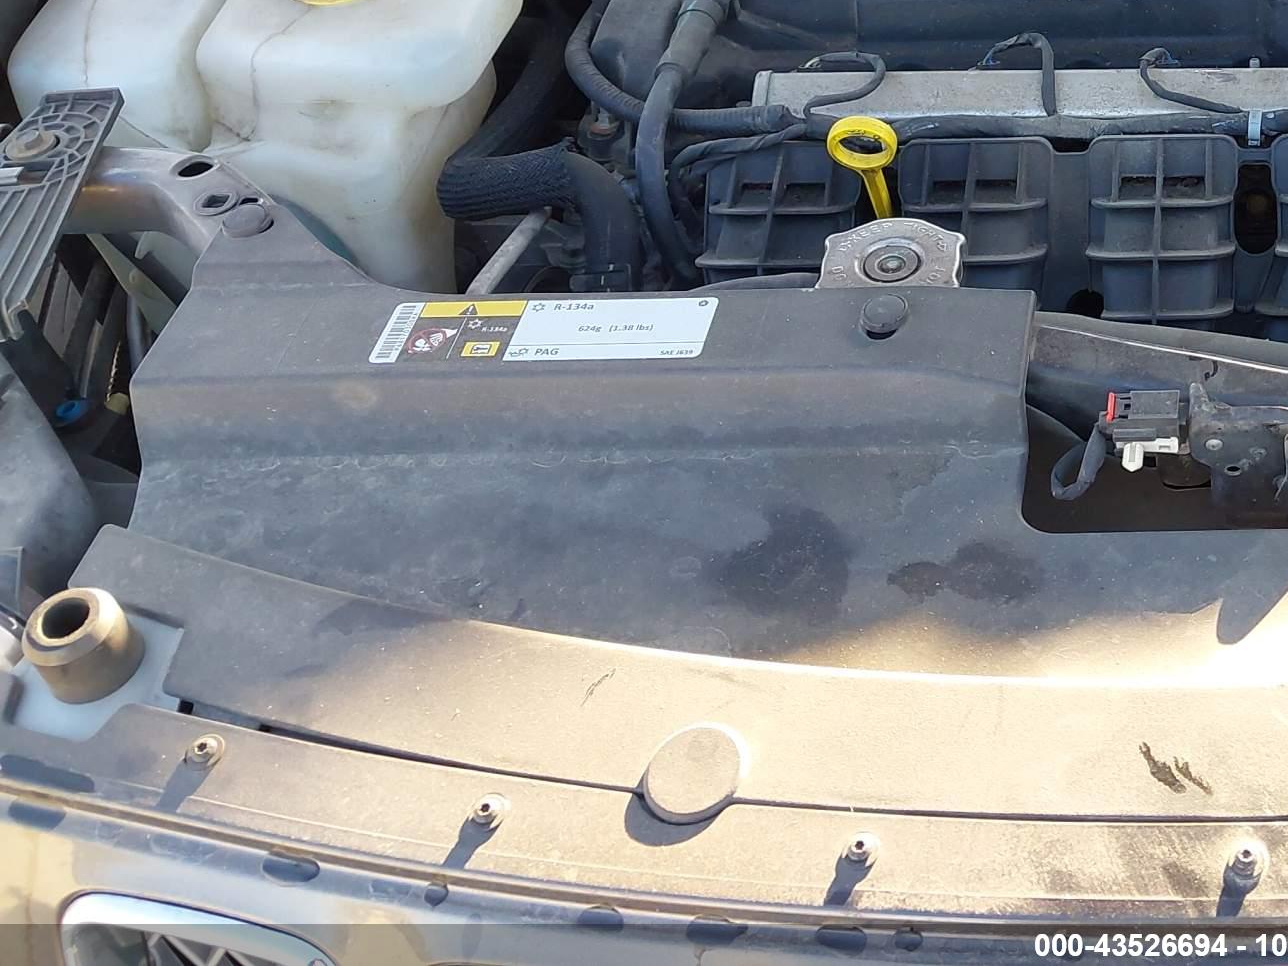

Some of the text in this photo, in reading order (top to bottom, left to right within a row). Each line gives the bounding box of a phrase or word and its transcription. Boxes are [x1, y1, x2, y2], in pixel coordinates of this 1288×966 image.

[553, 302, 595, 311] R-134a
[577, 323, 654, 333] 624g (1.38 lbs)
[534, 347, 560, 356] PAG
